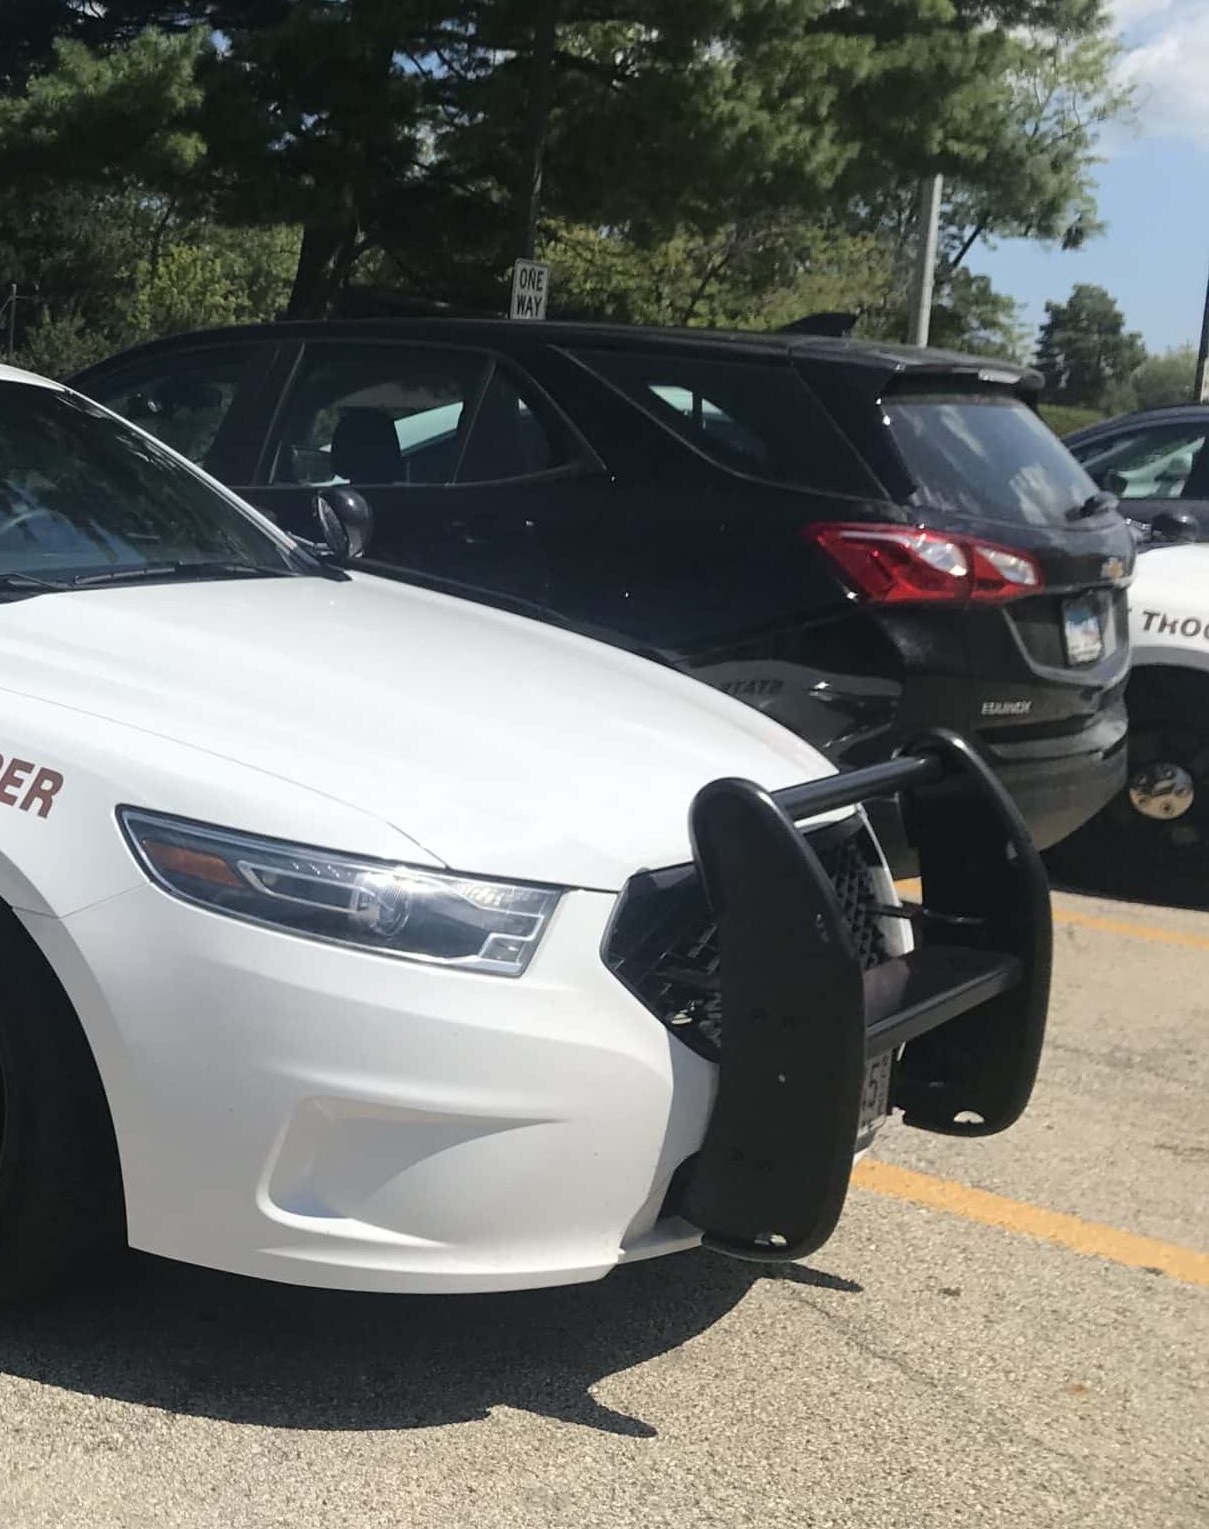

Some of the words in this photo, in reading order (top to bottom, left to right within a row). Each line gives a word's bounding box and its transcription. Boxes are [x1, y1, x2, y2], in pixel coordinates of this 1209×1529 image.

[519, 268, 544, 291] ONE
[517, 294, 543, 317] WAY
[1142, 609, 1209, 641] TRO
